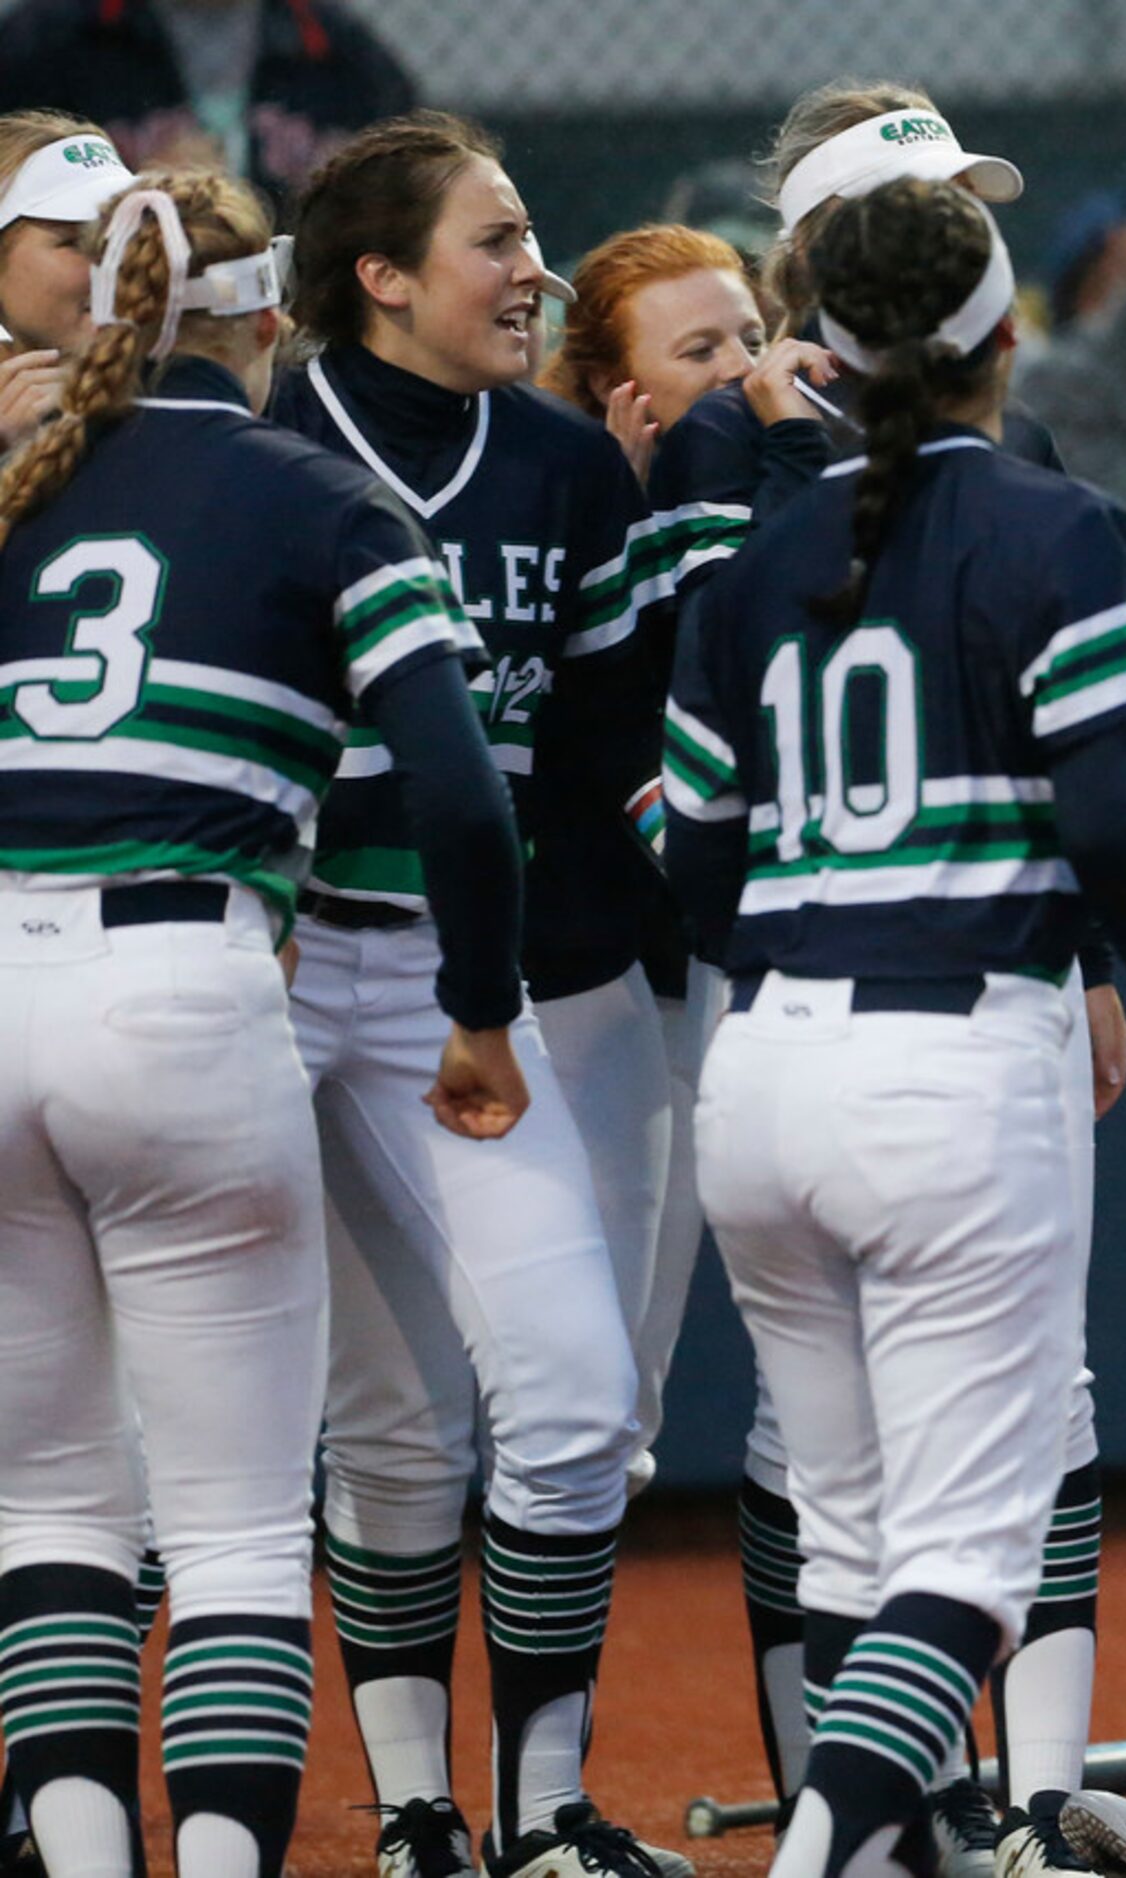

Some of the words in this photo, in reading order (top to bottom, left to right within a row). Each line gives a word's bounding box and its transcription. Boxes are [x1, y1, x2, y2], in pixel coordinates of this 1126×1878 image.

[11, 532, 169, 741] 3
[488, 655, 546, 724] 12
[758, 620, 924, 863] 10
